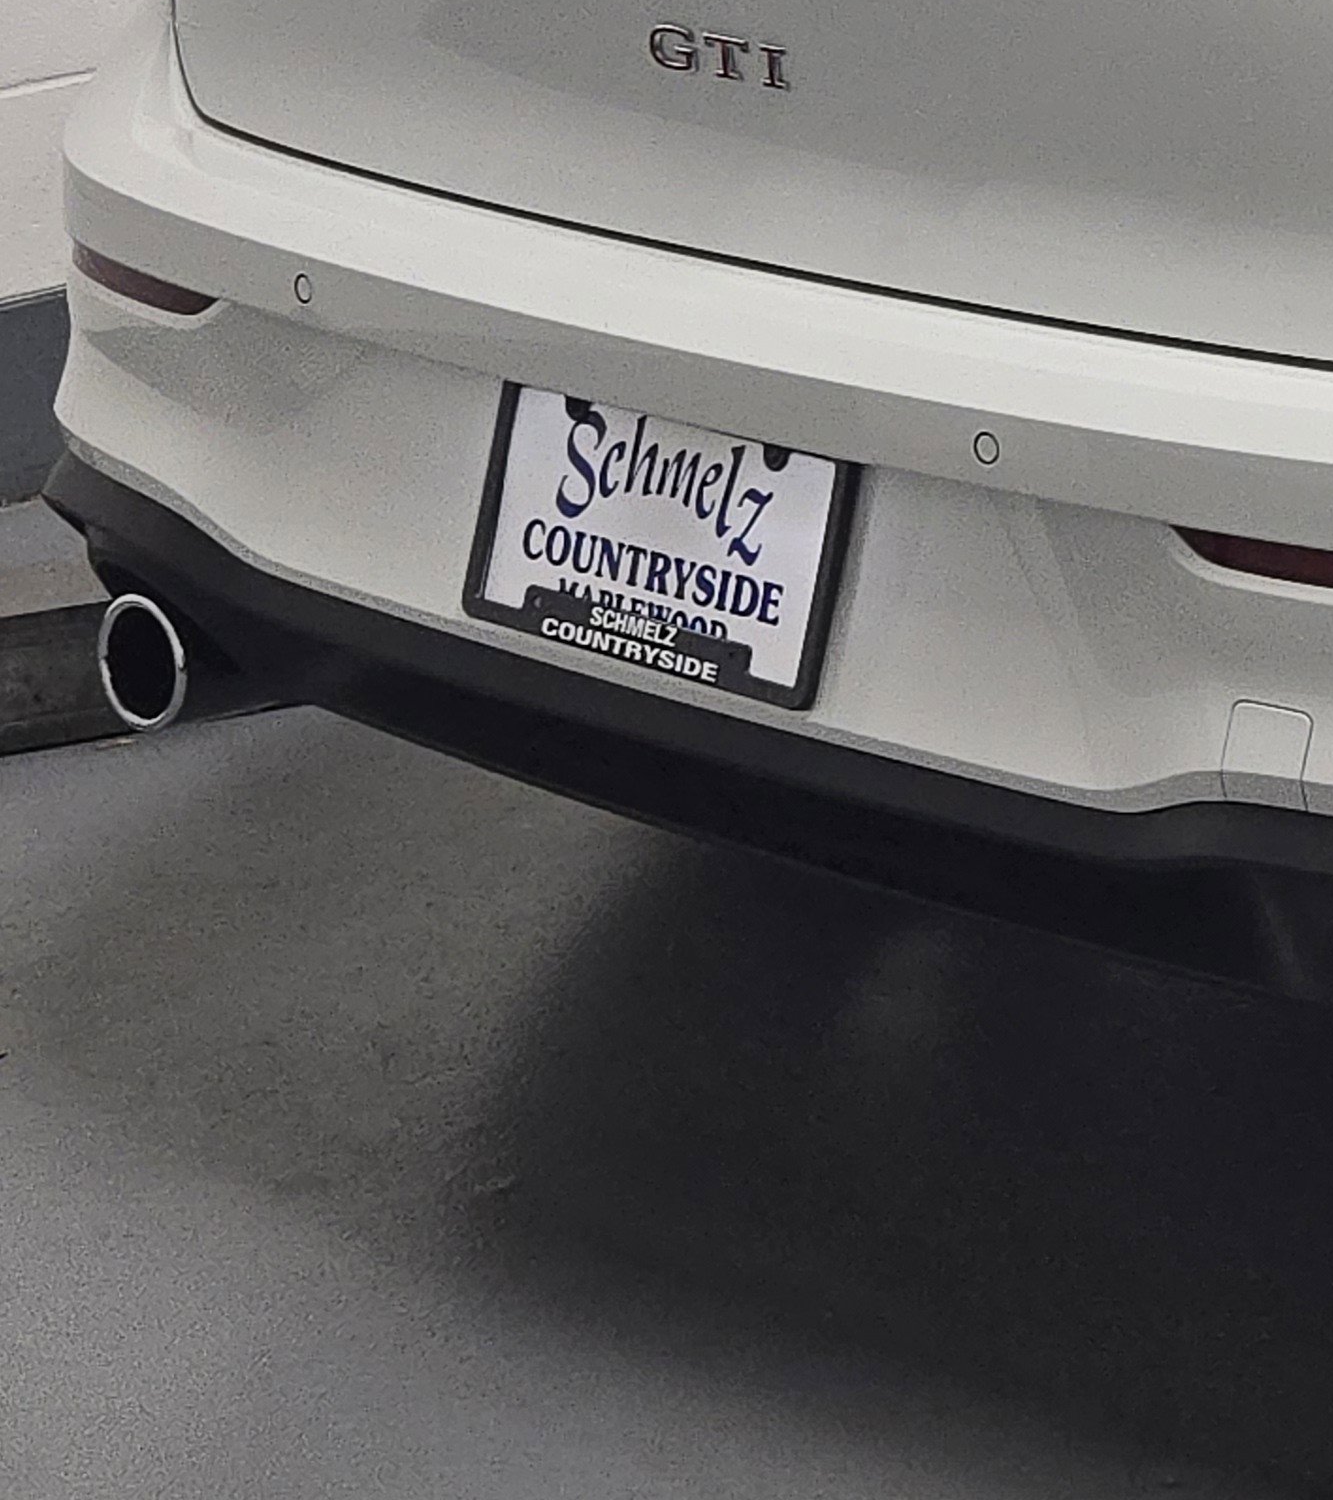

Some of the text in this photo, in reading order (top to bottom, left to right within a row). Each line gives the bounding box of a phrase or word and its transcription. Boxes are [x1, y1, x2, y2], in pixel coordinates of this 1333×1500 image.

[649, 24, 792, 90] GTI
[555, 409, 773, 566] Schmelz
[522, 518, 784, 626] COUNTRYSIDE
[540, 616, 719, 684] COUNTRYSIDE
[589, 605, 679, 648] SCHMELZ
